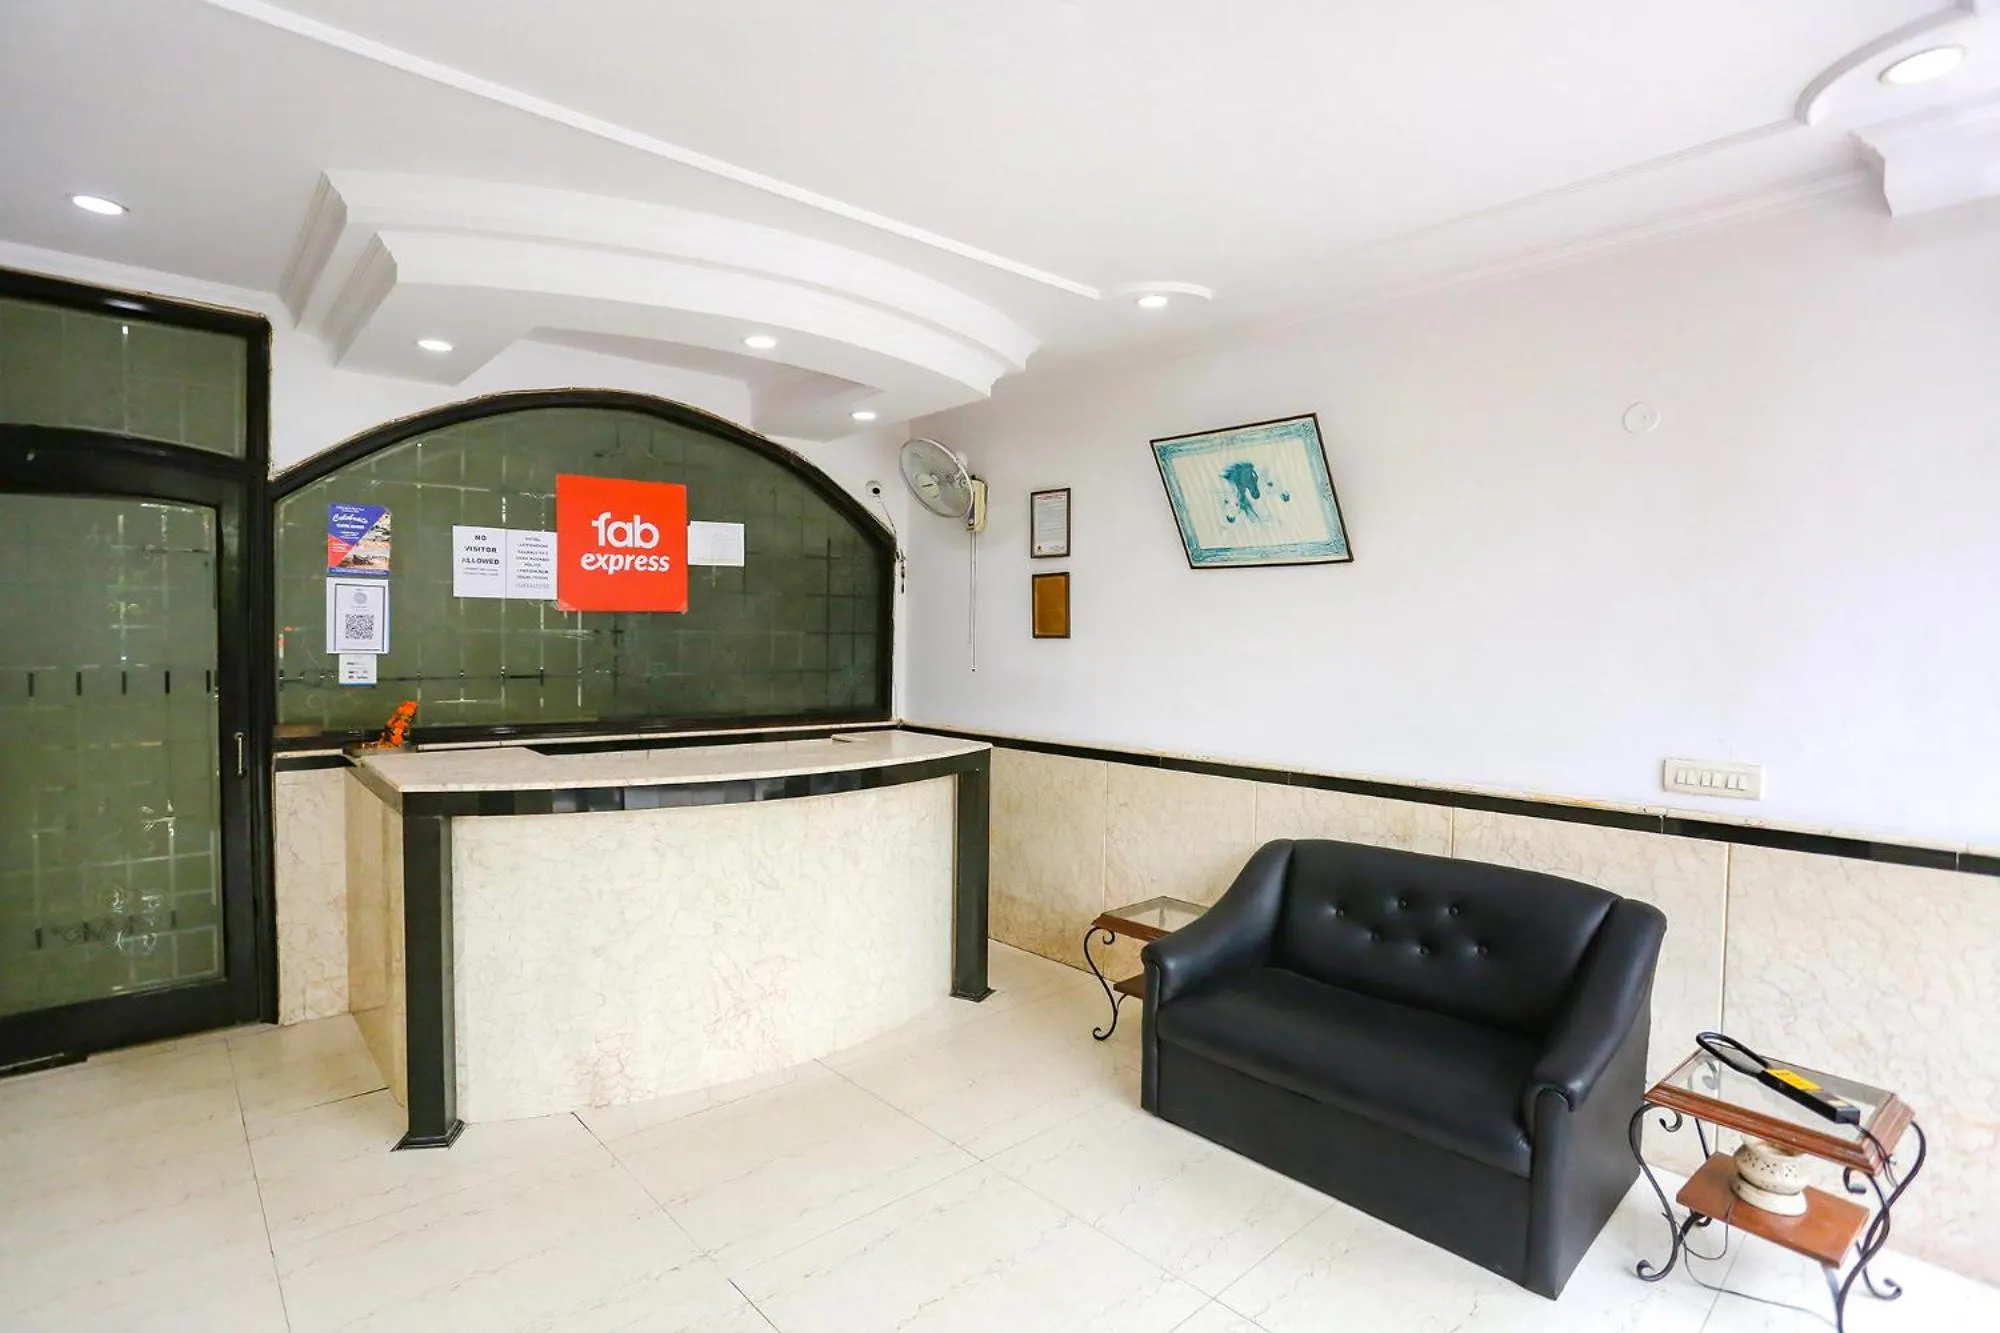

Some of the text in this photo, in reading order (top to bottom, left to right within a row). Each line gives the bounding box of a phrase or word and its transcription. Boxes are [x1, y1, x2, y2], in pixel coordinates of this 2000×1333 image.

[591, 511, 660, 549] fab
[463, 545, 497, 553] VISITOR
[461, 557, 500, 565] ALLOWED
[580, 552, 670, 575] express
